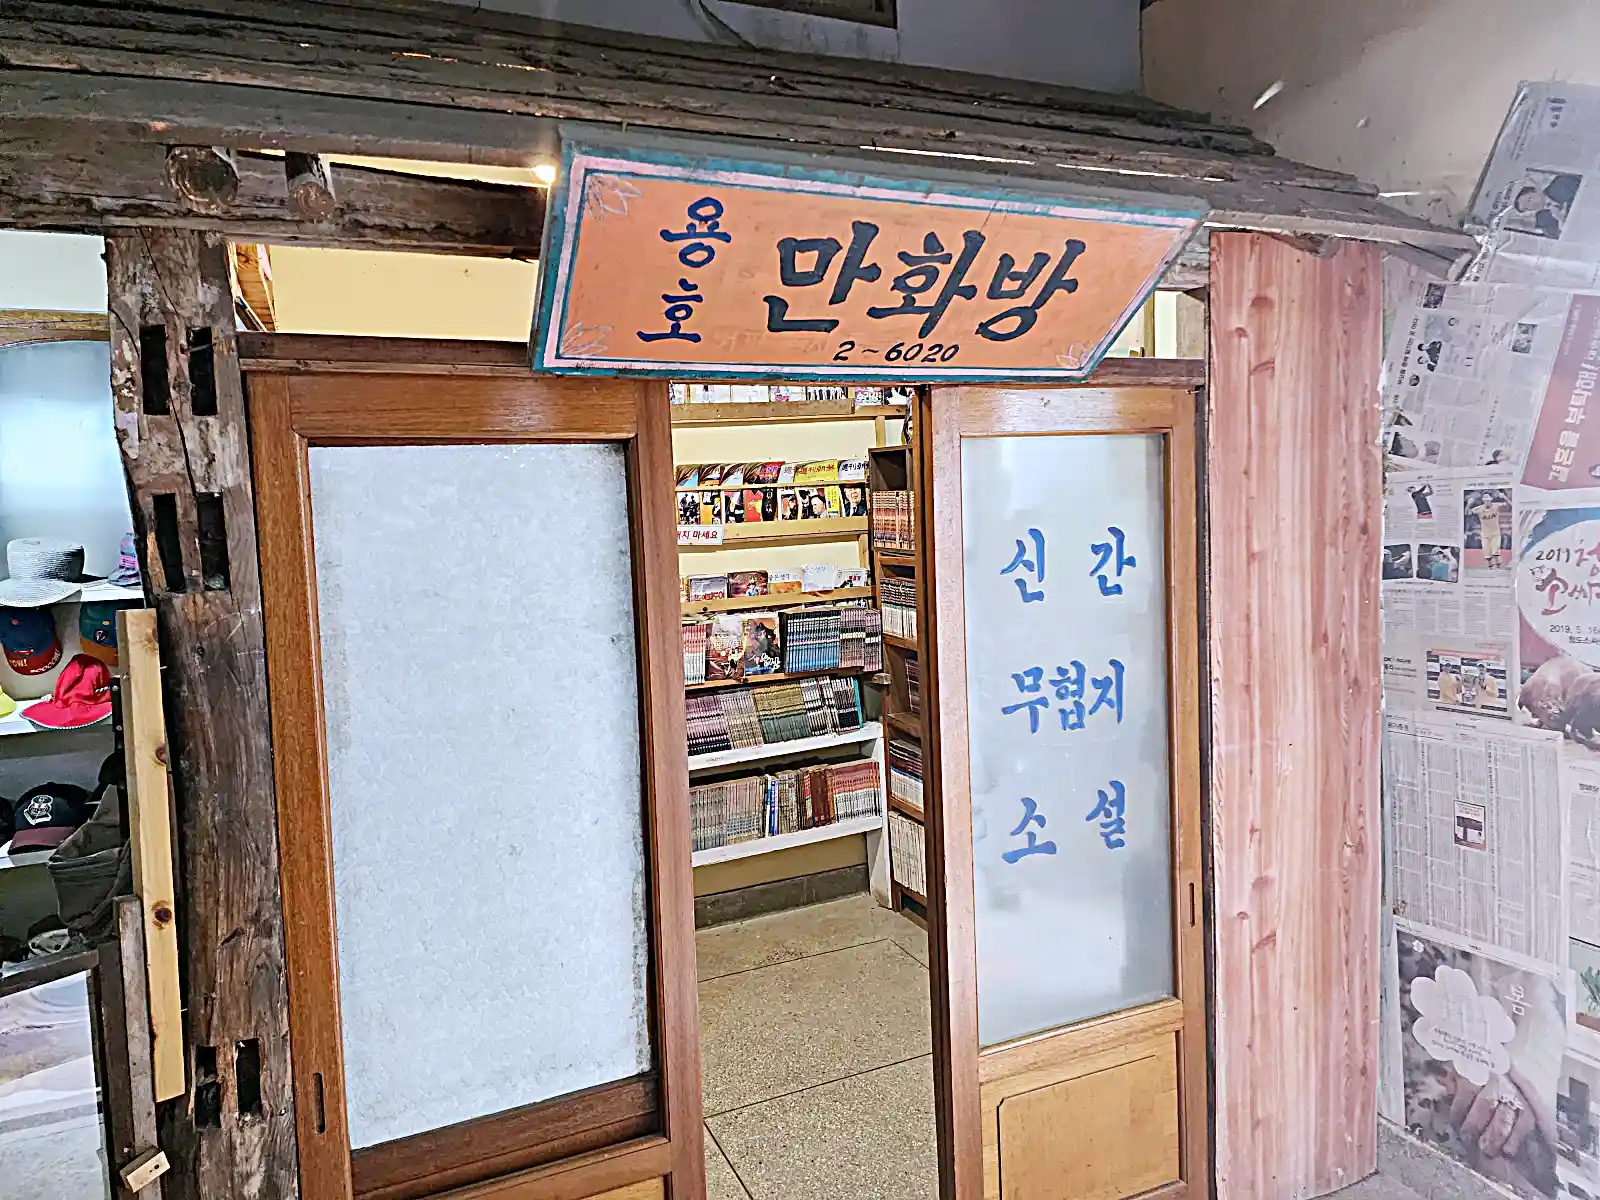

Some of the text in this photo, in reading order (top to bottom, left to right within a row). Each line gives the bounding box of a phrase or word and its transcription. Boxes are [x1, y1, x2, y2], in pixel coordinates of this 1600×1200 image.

[763, 219, 1087, 342] 만화방
[1549, 430, 1580, 484] 결혼을
[692, 530, 718, 540] 마세요
[1001, 659, 1126, 734] 무협지
